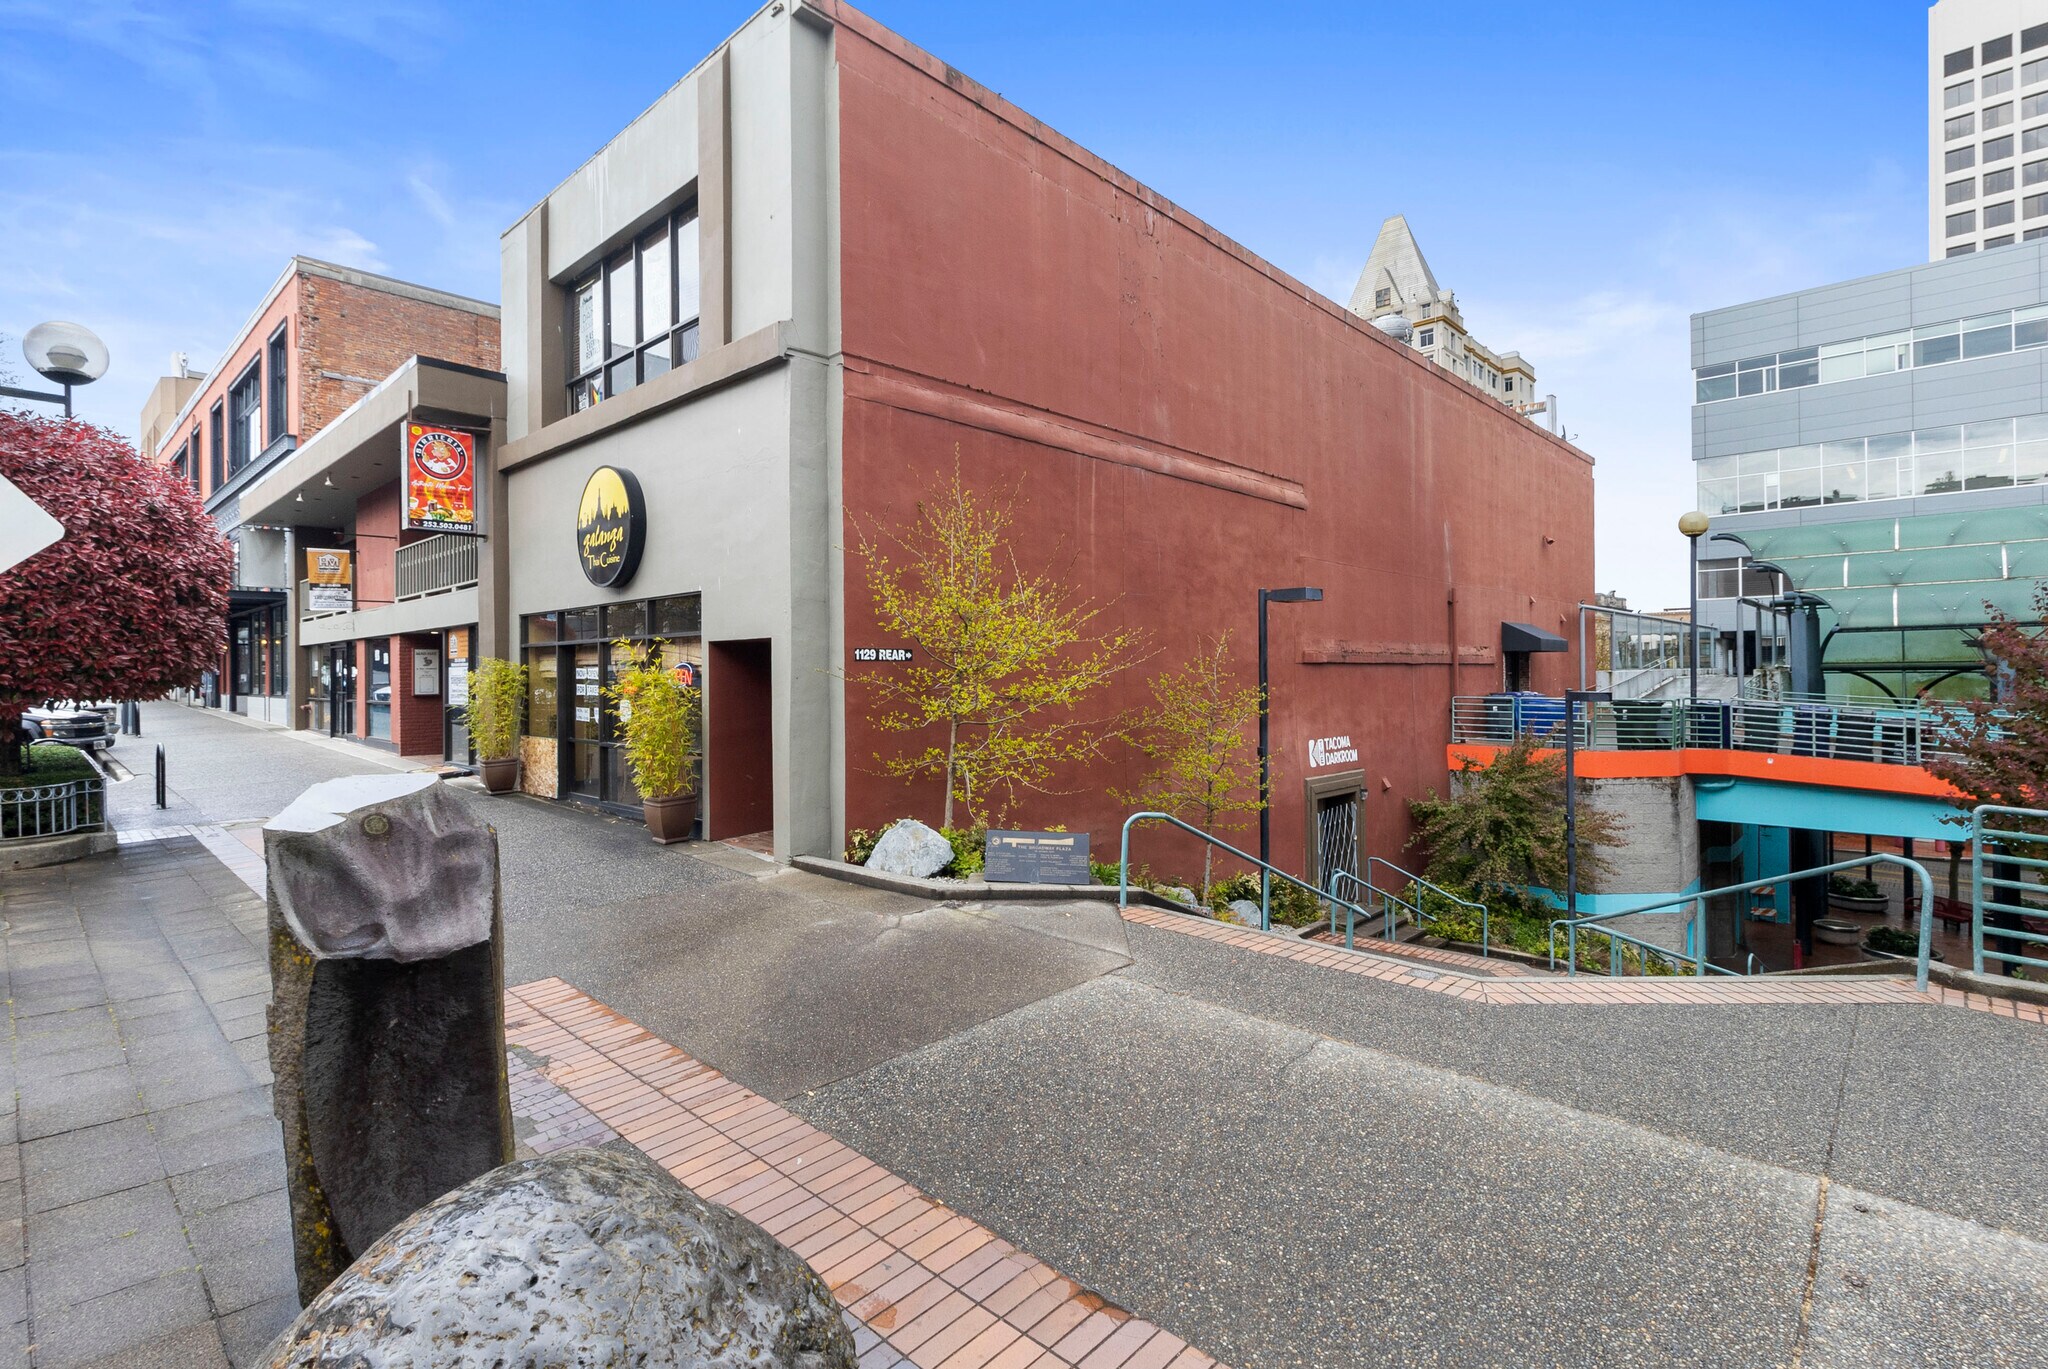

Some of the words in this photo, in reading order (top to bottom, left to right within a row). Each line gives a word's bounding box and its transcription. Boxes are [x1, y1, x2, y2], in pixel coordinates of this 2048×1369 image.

[415, 434, 463, 454] BIRRIERIA
[458, 484, 472, 492] Food
[423, 520, 472, 531] 253.503.0481
[583, 524, 624, 557] galanga
[587, 554, 600, 570] Thai
[600, 552, 620, 568] Cuisine
[855, 648, 876, 660] 1129
[879, 649, 905, 660] REAR
[1324, 736, 1351, 750] TACOMA
[1325, 749, 1358, 765] DARKROOM
